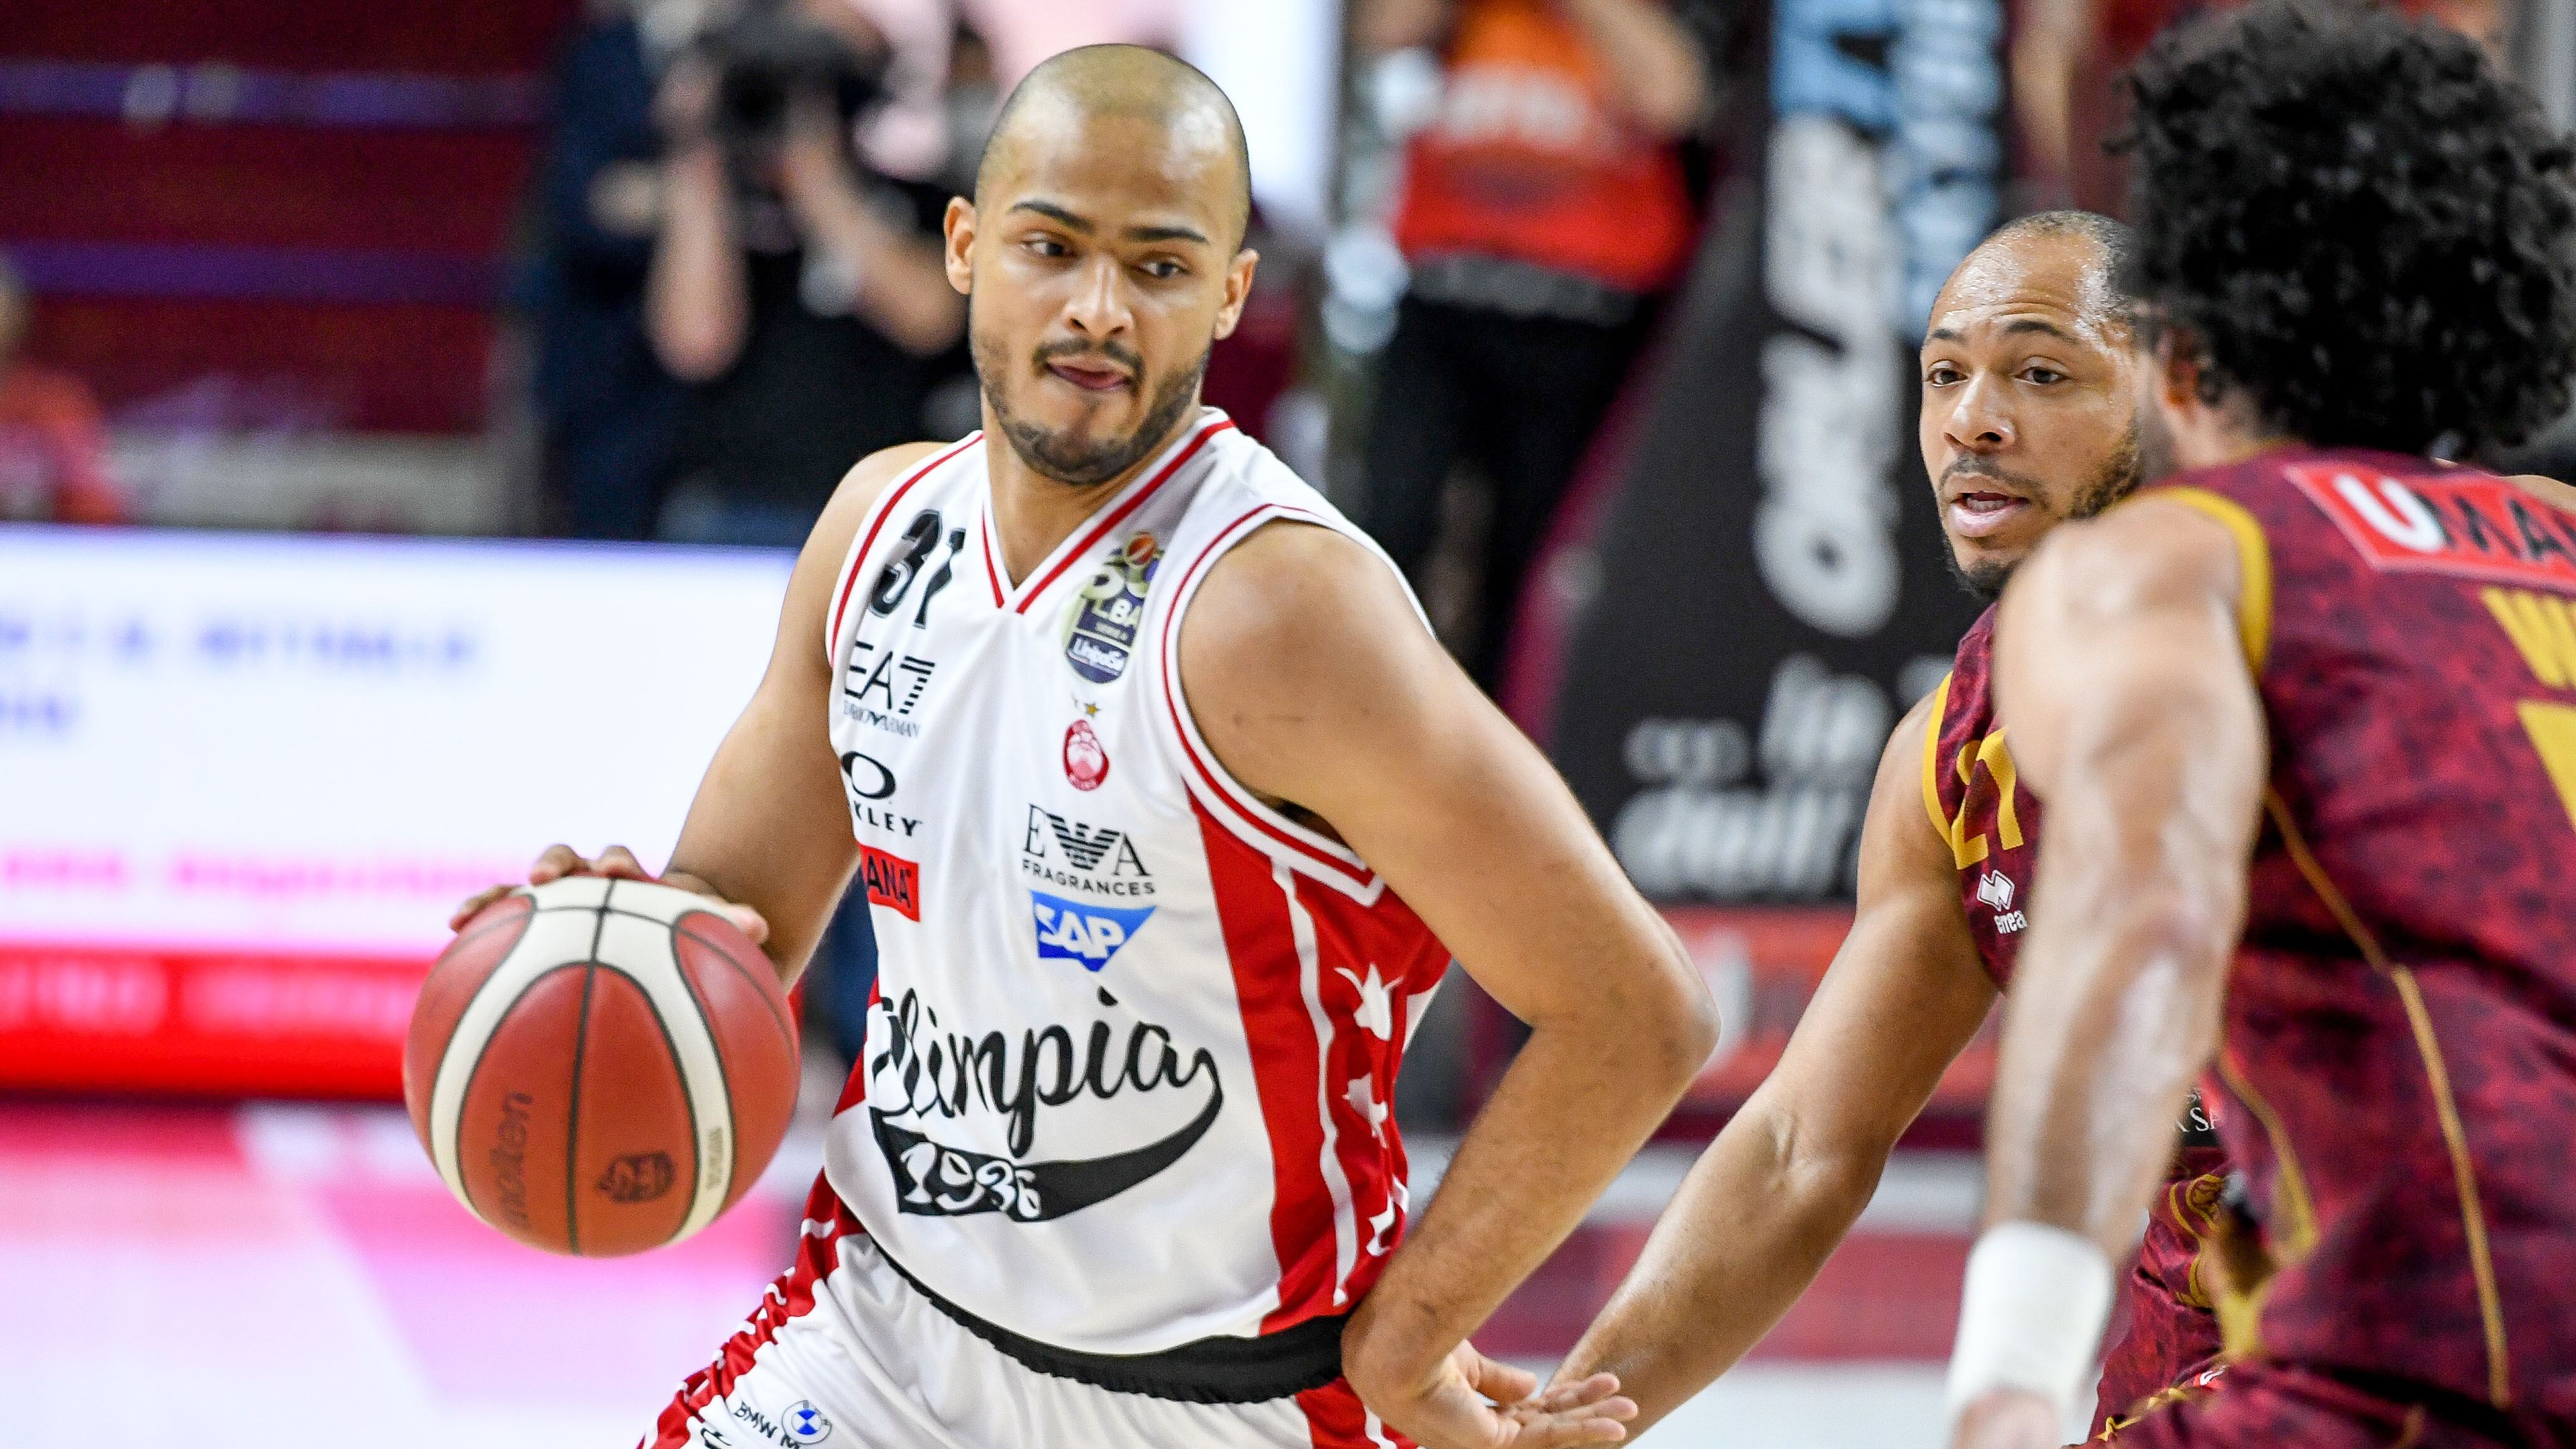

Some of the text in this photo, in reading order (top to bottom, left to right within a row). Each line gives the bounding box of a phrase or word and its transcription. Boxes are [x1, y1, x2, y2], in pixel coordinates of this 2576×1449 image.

[869, 508, 967, 629] 31
[844, 640, 936, 715] EA7
[1021, 858, 1157, 897] FRAGRANCES
[1035, 903, 1125, 960] SAP
[733, 1401, 779, 1439] BMW
